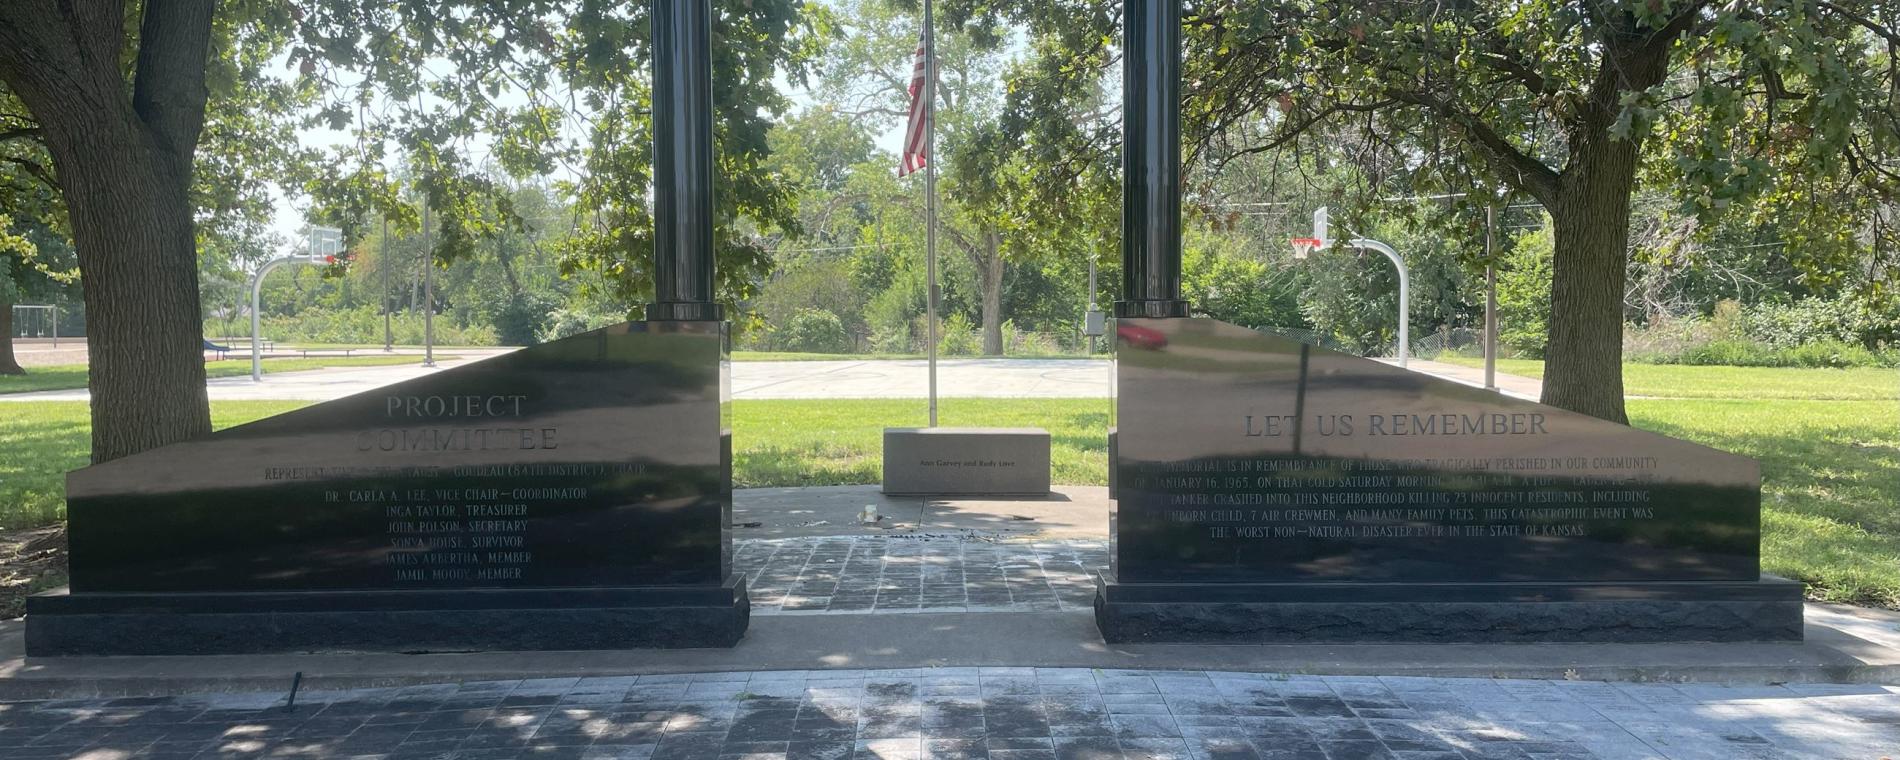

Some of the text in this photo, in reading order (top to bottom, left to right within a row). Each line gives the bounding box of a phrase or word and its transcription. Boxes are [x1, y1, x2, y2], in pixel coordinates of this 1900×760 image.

[386, 395, 529, 418] PROJECT
[1244, 412, 1549, 437] LET US REMEMBER
[357, 428, 559, 451] COMMITTEE
[936, 459, 961, 469] Garvey
[963, 459, 977, 467] and
[1239, 459, 1252, 472] IN
[1256, 459, 1336, 472] REMEMBRANCE
[1339, 459, 1354, 471] OF
[1358, 458, 1393, 471] THOSE
[1426, 457, 1490, 471] TRAGICALLY
[1495, 457, 1547, 470] PERISHED
[1550, 457, 1562, 470] IN
[1565, 457, 1588, 470] OUR
[1592, 456, 1658, 469] COMMUNITY
[1257, 476, 1273, 488] ON
[1276, 476, 1303, 488] THAT
[1307, 476, 1335, 488] COLD
[1339, 475, 1392, 488] SATURDAY
[325, 489, 345, 503] DR.
[349, 489, 387, 503] CARLA
[434, 488, 460, 502] VICE
[1213, 493, 1262, 505] CRASHED
[1266, 492, 1290, 504] INTO
[1293, 492, 1318, 504] THIS
[1322, 491, 1405, 504] NEIGHBORHOOD
[1408, 491, 1450, 504] KILLING
[1453, 491, 1467, 504] 23
[1470, 490, 1524, 503] INNOCENT
[1592, 489, 1650, 503] INCLUDING
[386, 505, 413, 518] INGA
[465, 503, 529, 517] TREASURER
[1250, 509, 1257, 521] 7
[1260, 509, 1280, 521] AIR
[1345, 508, 1369, 521] AND
[1371, 508, 1403, 521] MANY
[1407, 508, 1445, 521] FAMILY
[1482, 508, 1507, 520] THIS
[1511, 507, 1589, 520] CATASTROPHIC
[1593, 507, 1627, 519] EVENT
[1631, 506, 1655, 519] WAS
[386, 521, 415, 534] JOHN
[468, 519, 529, 533] SECRETARY
[1208, 527, 1232, 539] THE
[1234, 526, 1271, 539] WORST
[1362, 525, 1412, 538] DISASTER
[1417, 525, 1444, 537] EVER
[1448, 524, 1460, 537] IN
[1463, 524, 1485, 537] THE
[1489, 524, 1520, 537] STATE
[1524, 524, 1538, 537] OF
[1541, 524, 1584, 537] KANSAS
[472, 535, 525, 548] SURVIVOR
[488, 550, 533, 564] MEMBER
[478, 566, 523, 580] MEMBER
